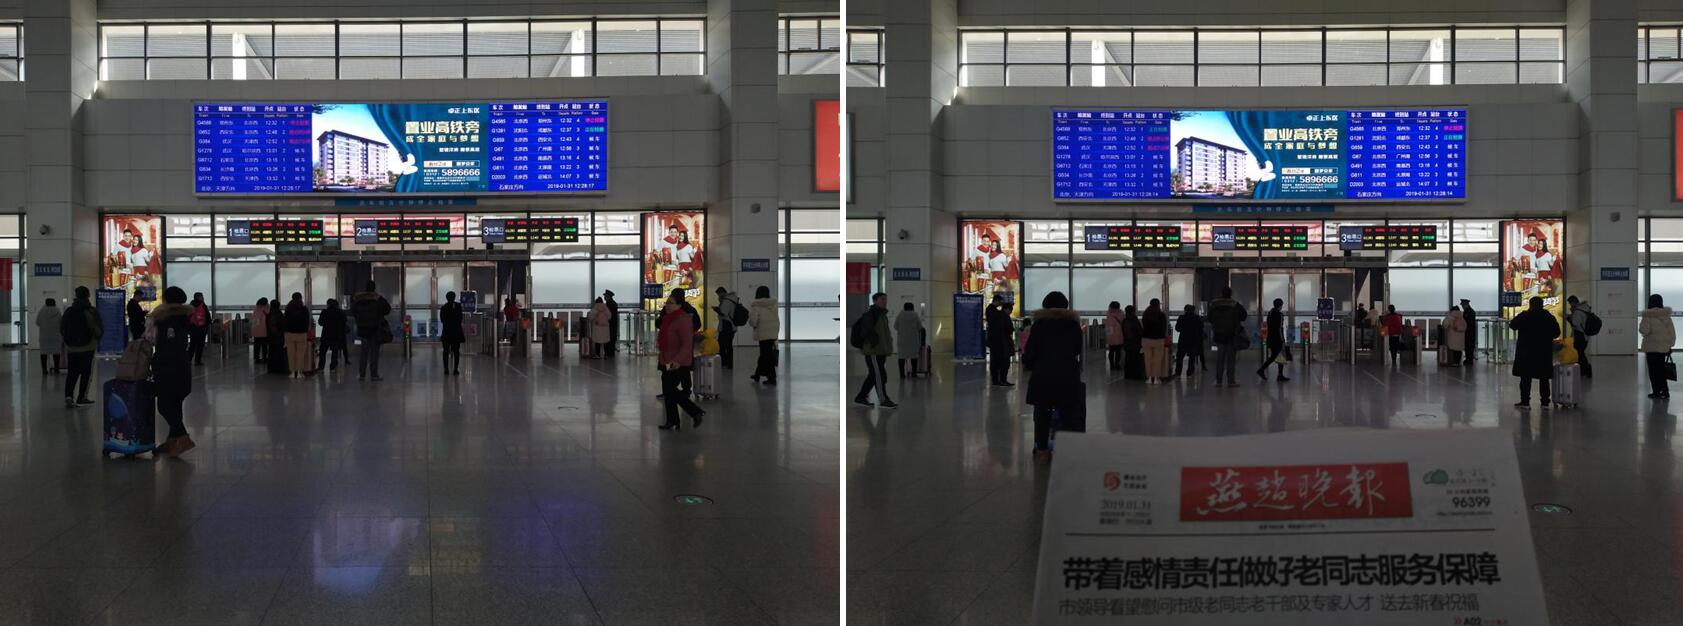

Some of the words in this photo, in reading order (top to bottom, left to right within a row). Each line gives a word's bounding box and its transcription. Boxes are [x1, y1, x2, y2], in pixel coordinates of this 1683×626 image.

[405, 120, 480, 134] 置业高铁旁
[405, 135, 479, 143] 成全家庭与梦想
[1264, 128, 1338, 141] 置业高铁旁
[1264, 142, 1338, 150] 成全家庭与梦想
[441, 168, 480, 176] 5896666
[1100, 499, 1151, 510] 2019.01.31
[1452, 496, 1490, 508] 96399
[1063, 553, 1501, 590] 带着感情责任做好老同志服务保障
[1058, 594, 1374, 616] 市领导看望慰问市级老同志老干部及专家人才
[1380, 593, 1480, 612] 送去新春祝福
[1463, 617, 1482, 626] A02
